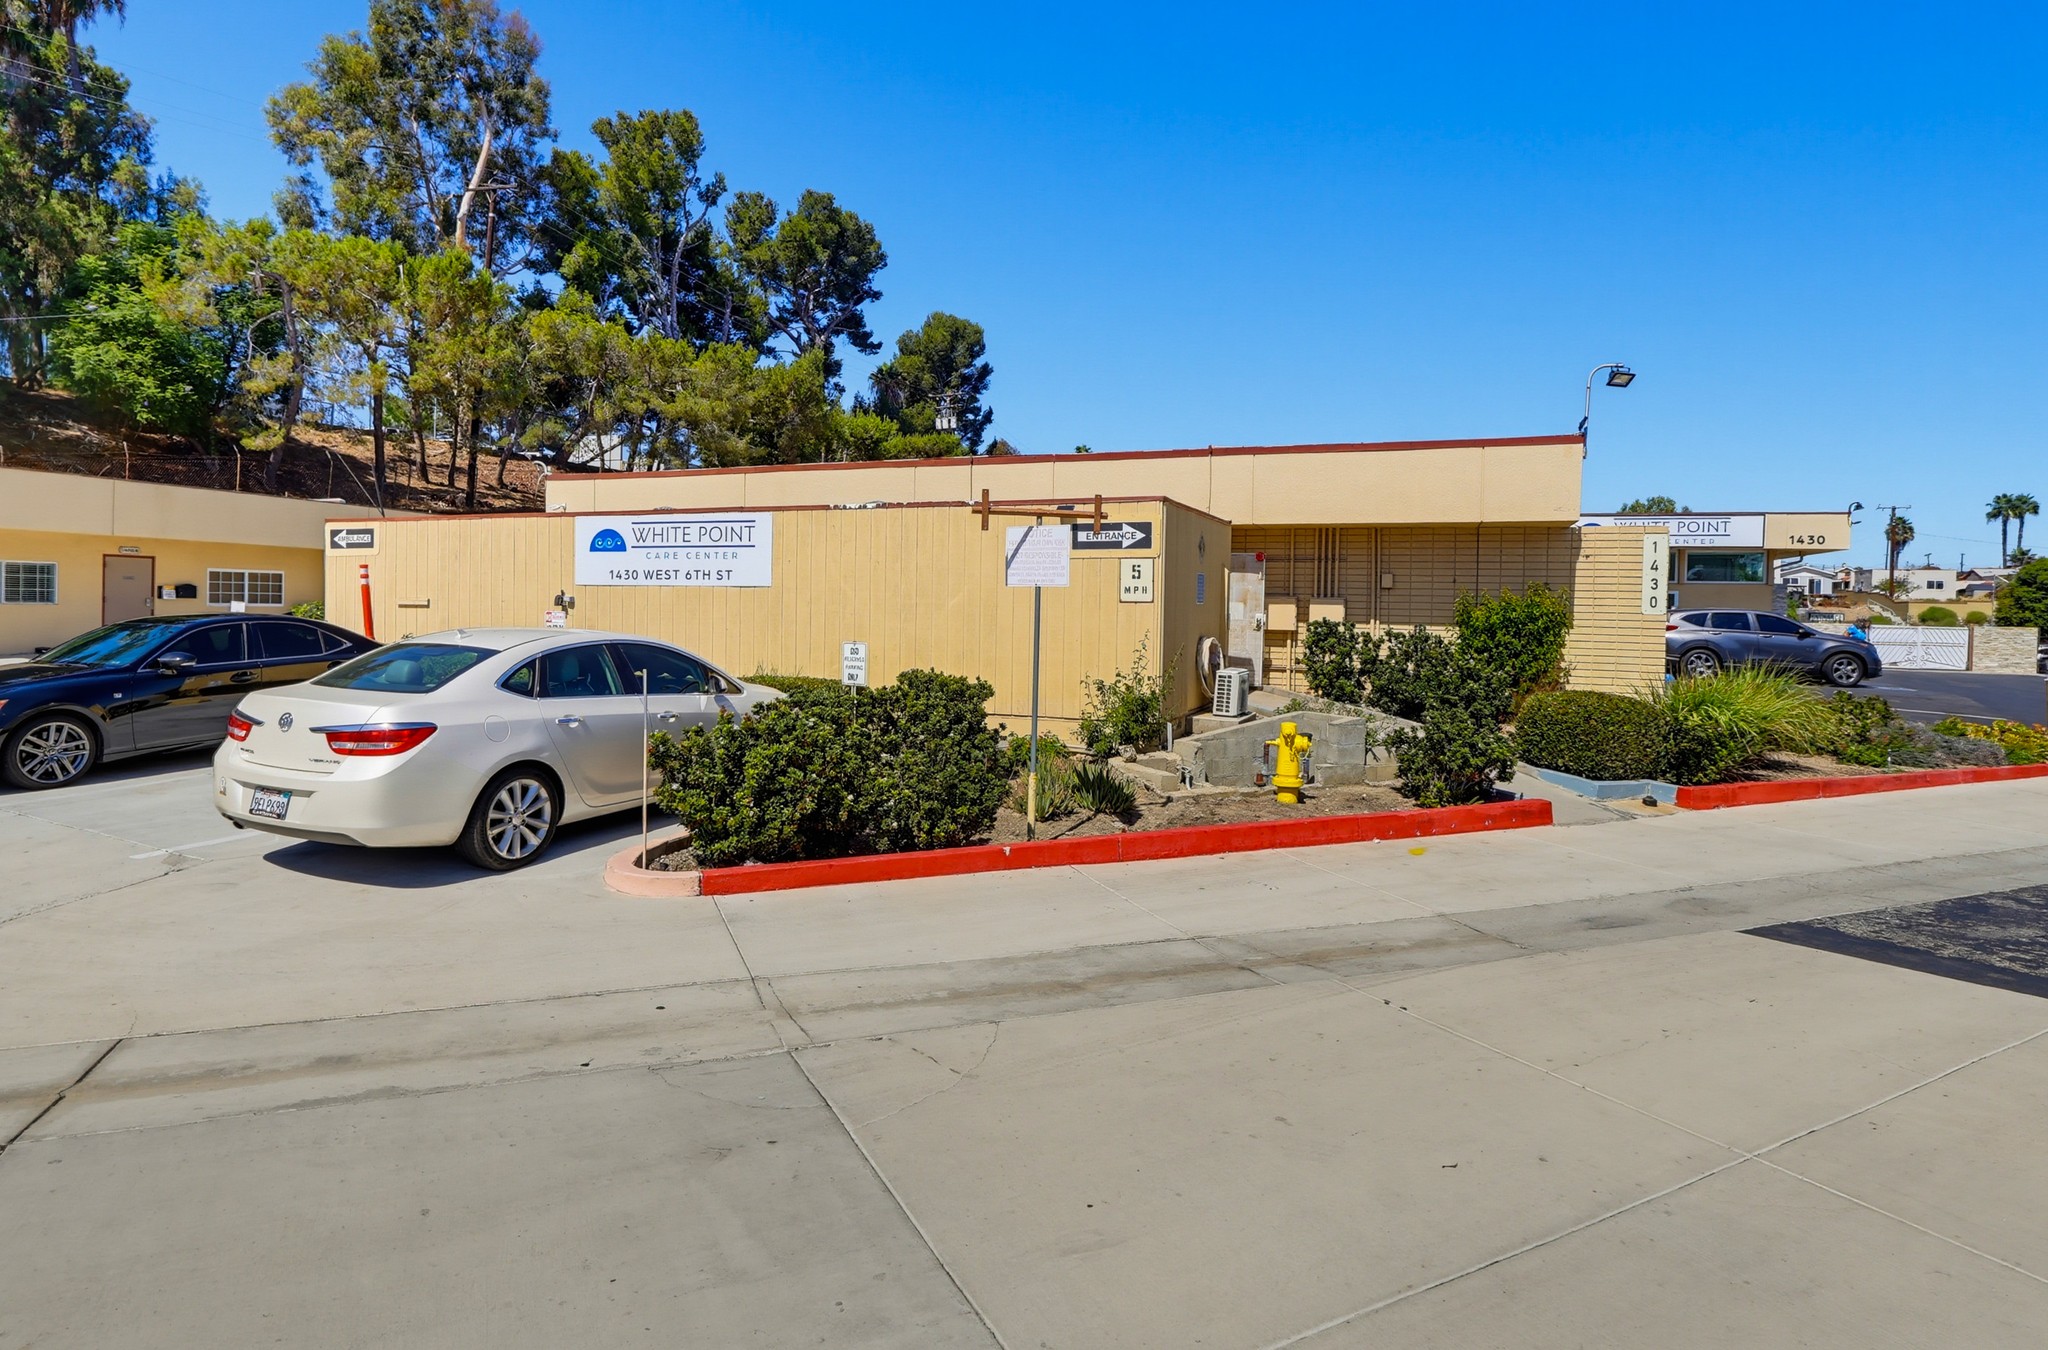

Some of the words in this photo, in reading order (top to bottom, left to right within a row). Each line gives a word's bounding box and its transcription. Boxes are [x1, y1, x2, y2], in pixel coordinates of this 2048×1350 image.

[1023, 528, 1053, 538] OTICE
[1677, 521, 1731, 533] POINT
[631, 526, 692, 544] WHITE
[698, 525, 756, 543] POINT
[1086, 531, 1137, 541] ENTRANCE
[1789, 535, 1826, 545] 1430
[645, 551, 679, 560] CARE
[686, 551, 739, 560] CENTER
[608, 569, 639, 581] 1430
[643, 569, 680, 581] WEST
[685, 569, 712, 581] 6TH
[716, 569, 733, 581] ST
[1131, 564, 1142, 580] 5
[1650, 541, 1659, 608] 1430
